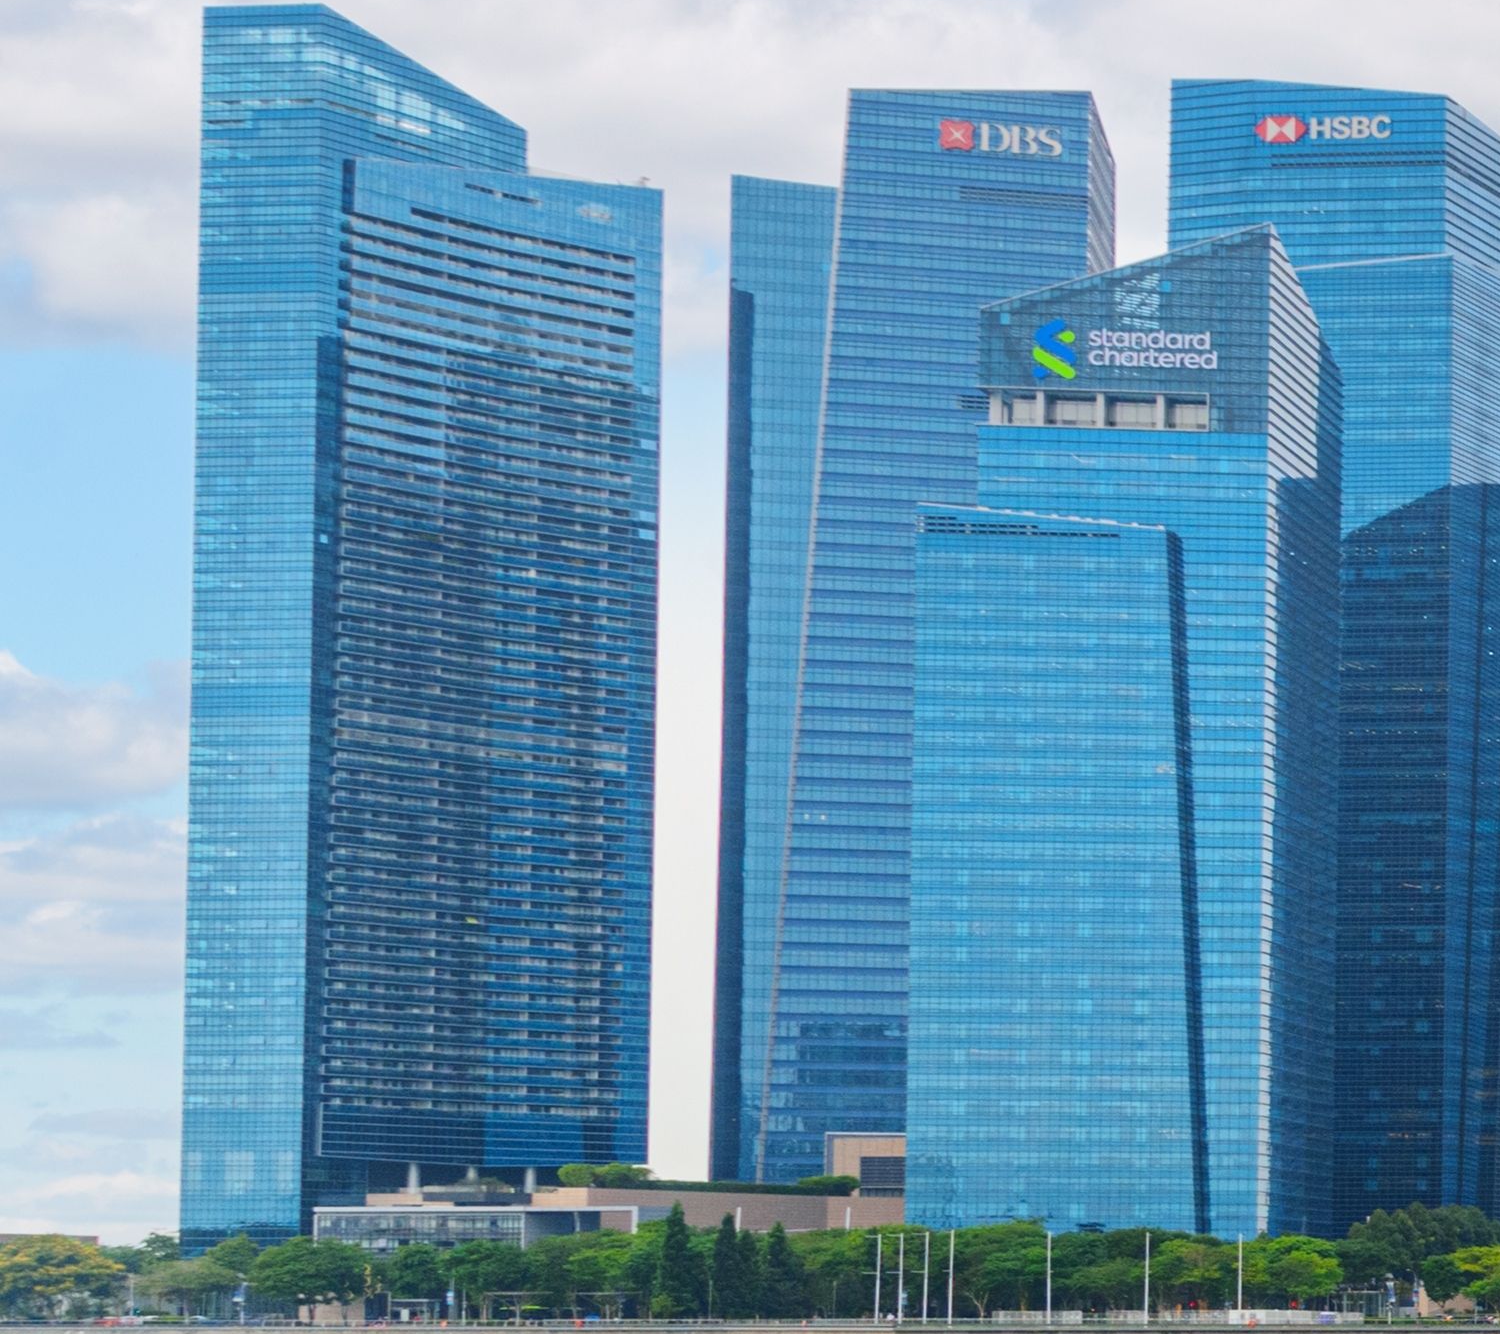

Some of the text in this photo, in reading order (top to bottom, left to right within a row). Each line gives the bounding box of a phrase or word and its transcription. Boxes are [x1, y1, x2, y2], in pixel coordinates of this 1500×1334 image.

[979, 121, 1063, 157] DBS
[1309, 115, 1392, 140] HSBC
[1088, 328, 1211, 350] standard
[1087, 347, 1218, 370] chartered
